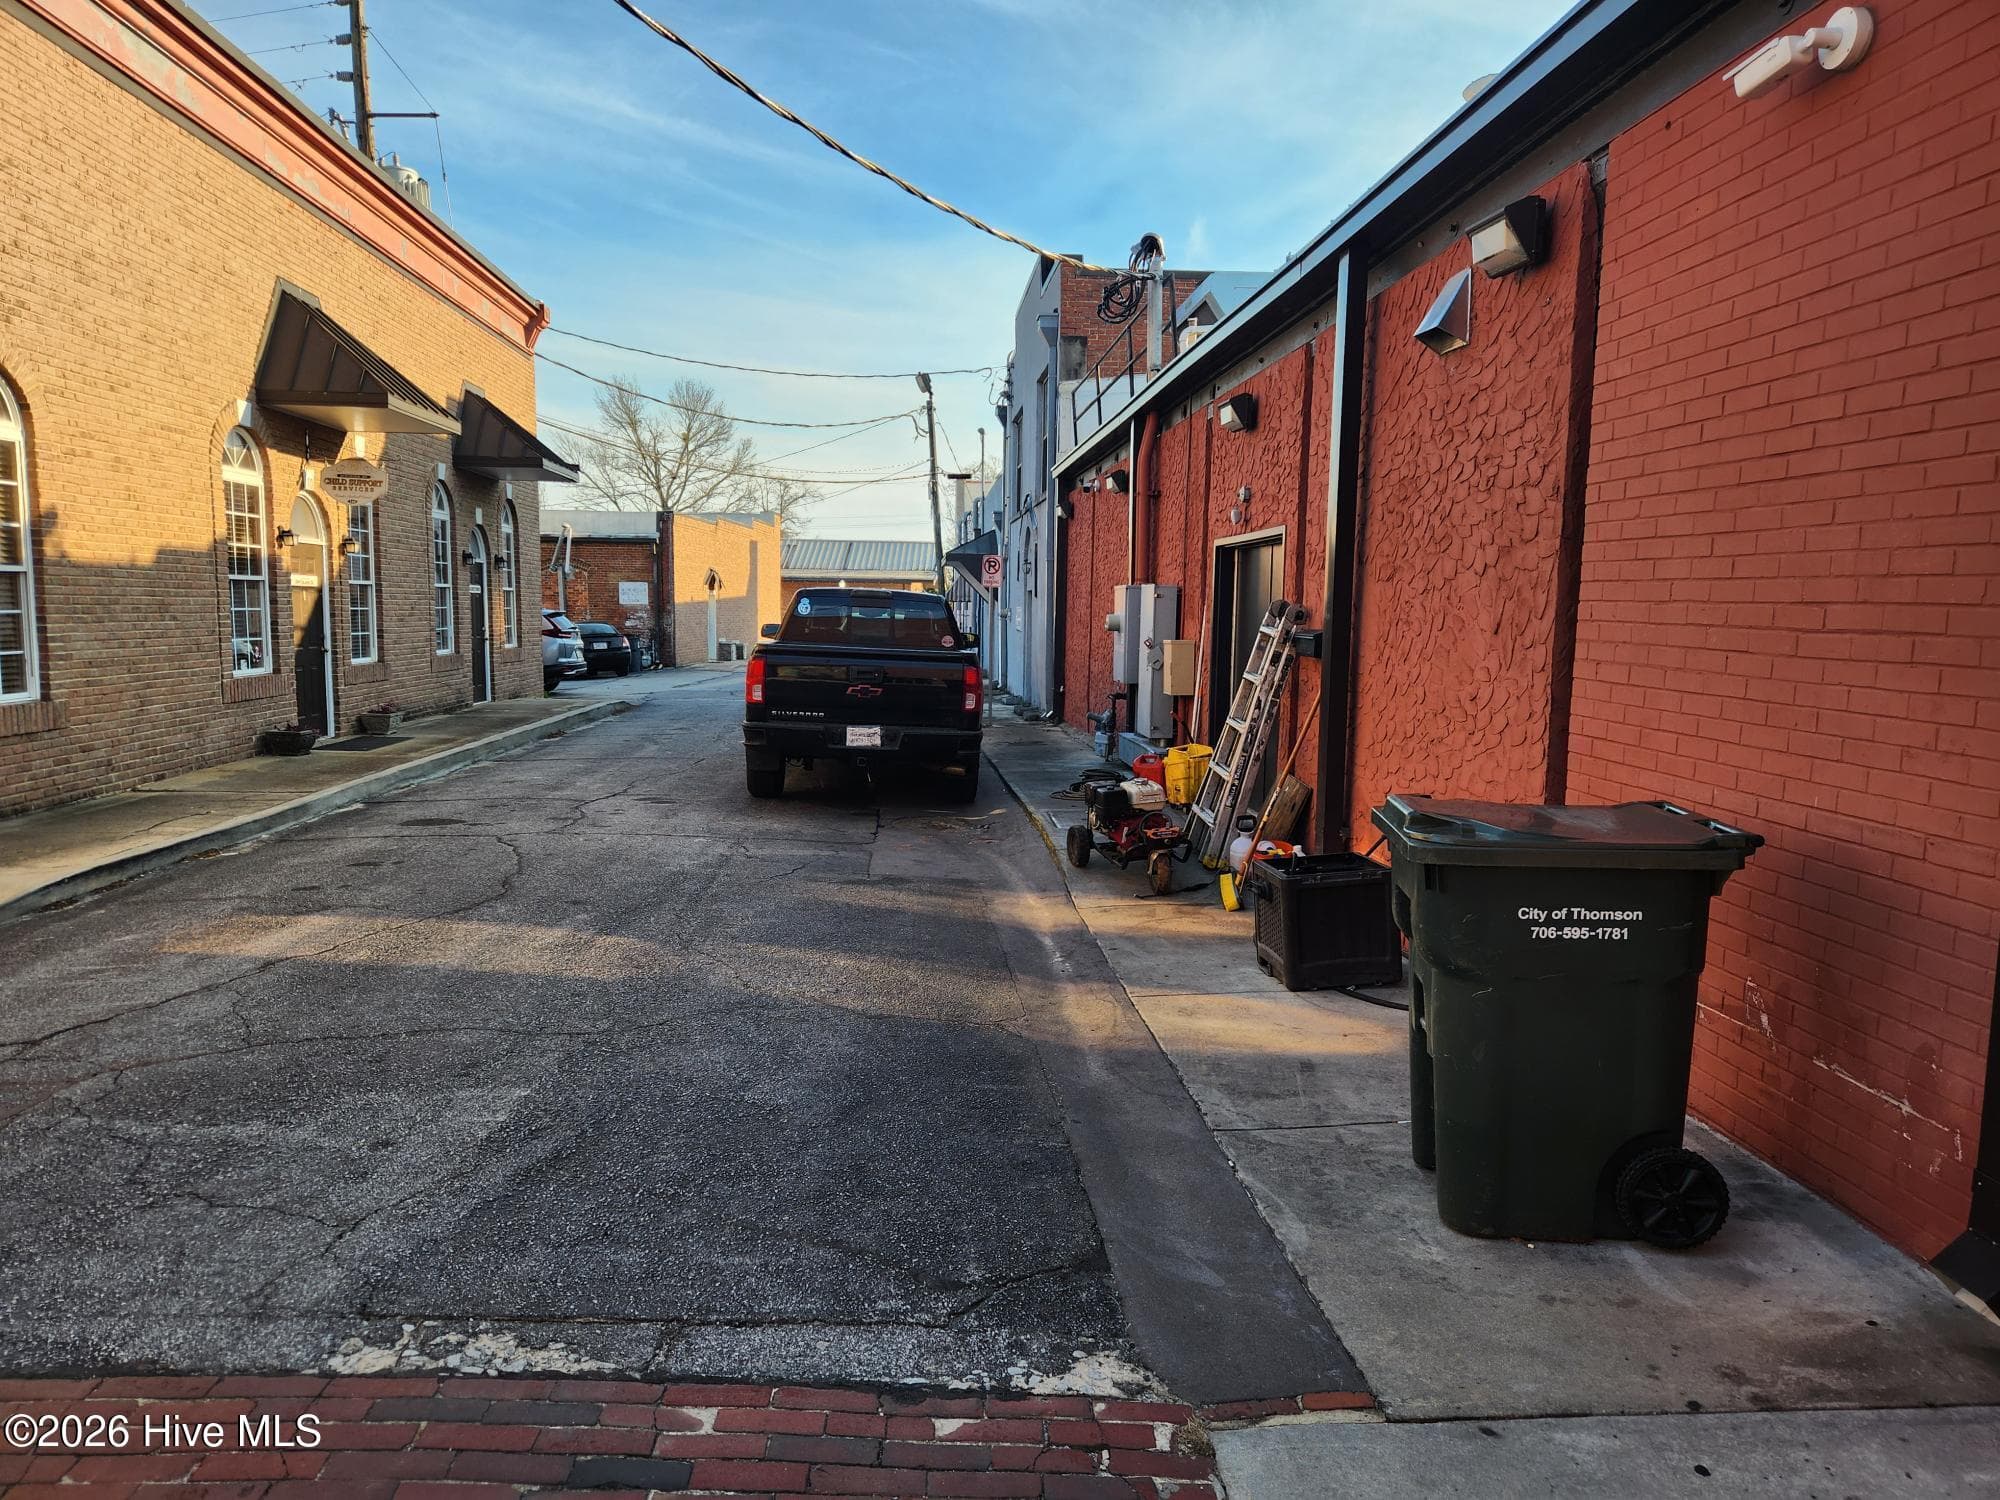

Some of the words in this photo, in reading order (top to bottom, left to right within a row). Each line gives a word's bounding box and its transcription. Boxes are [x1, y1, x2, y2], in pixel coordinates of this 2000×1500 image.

[324, 477, 347, 485] CHILD
[348, 479, 384, 487] SUPPORT
[1518, 907, 1548, 922] City
[1551, 907, 1568, 920] of
[1570, 907, 1643, 920] Thomson
[1530, 926, 1628, 940] 706-595-1781
